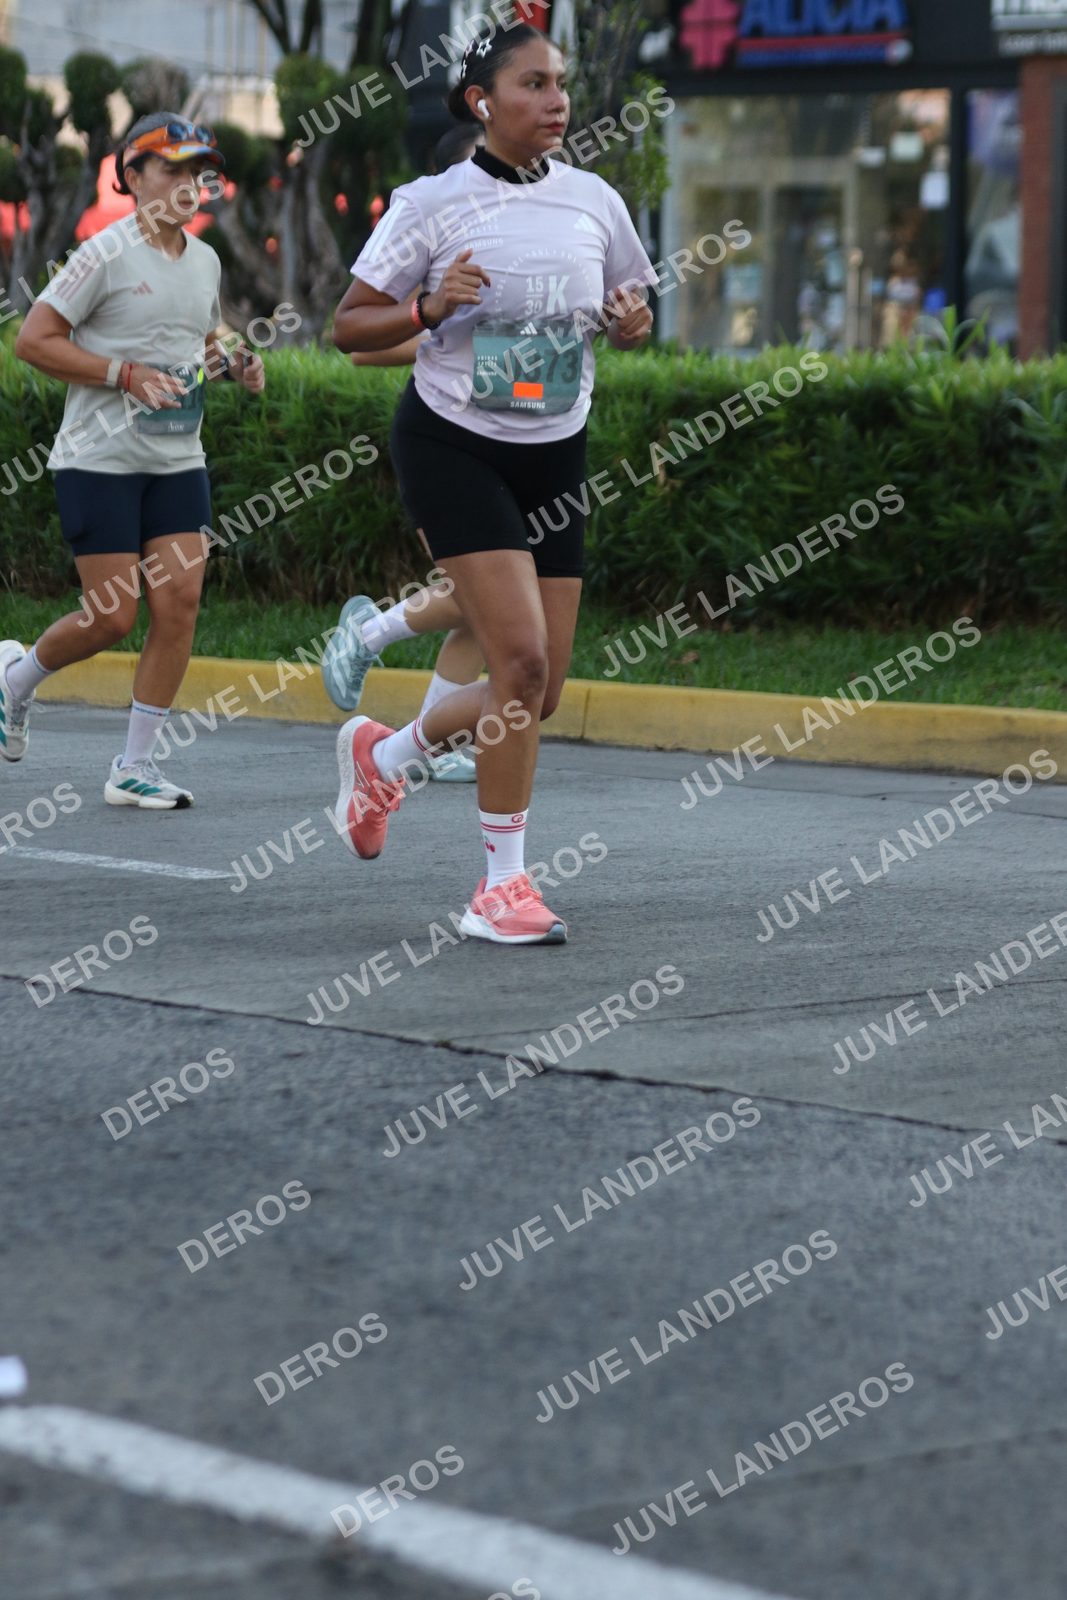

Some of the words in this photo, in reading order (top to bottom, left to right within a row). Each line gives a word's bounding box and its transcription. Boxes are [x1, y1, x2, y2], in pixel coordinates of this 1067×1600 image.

[526, 276, 543, 293] 15
[547, 275, 570, 314] K
[510, 401, 546, 409] SAMSUNG
